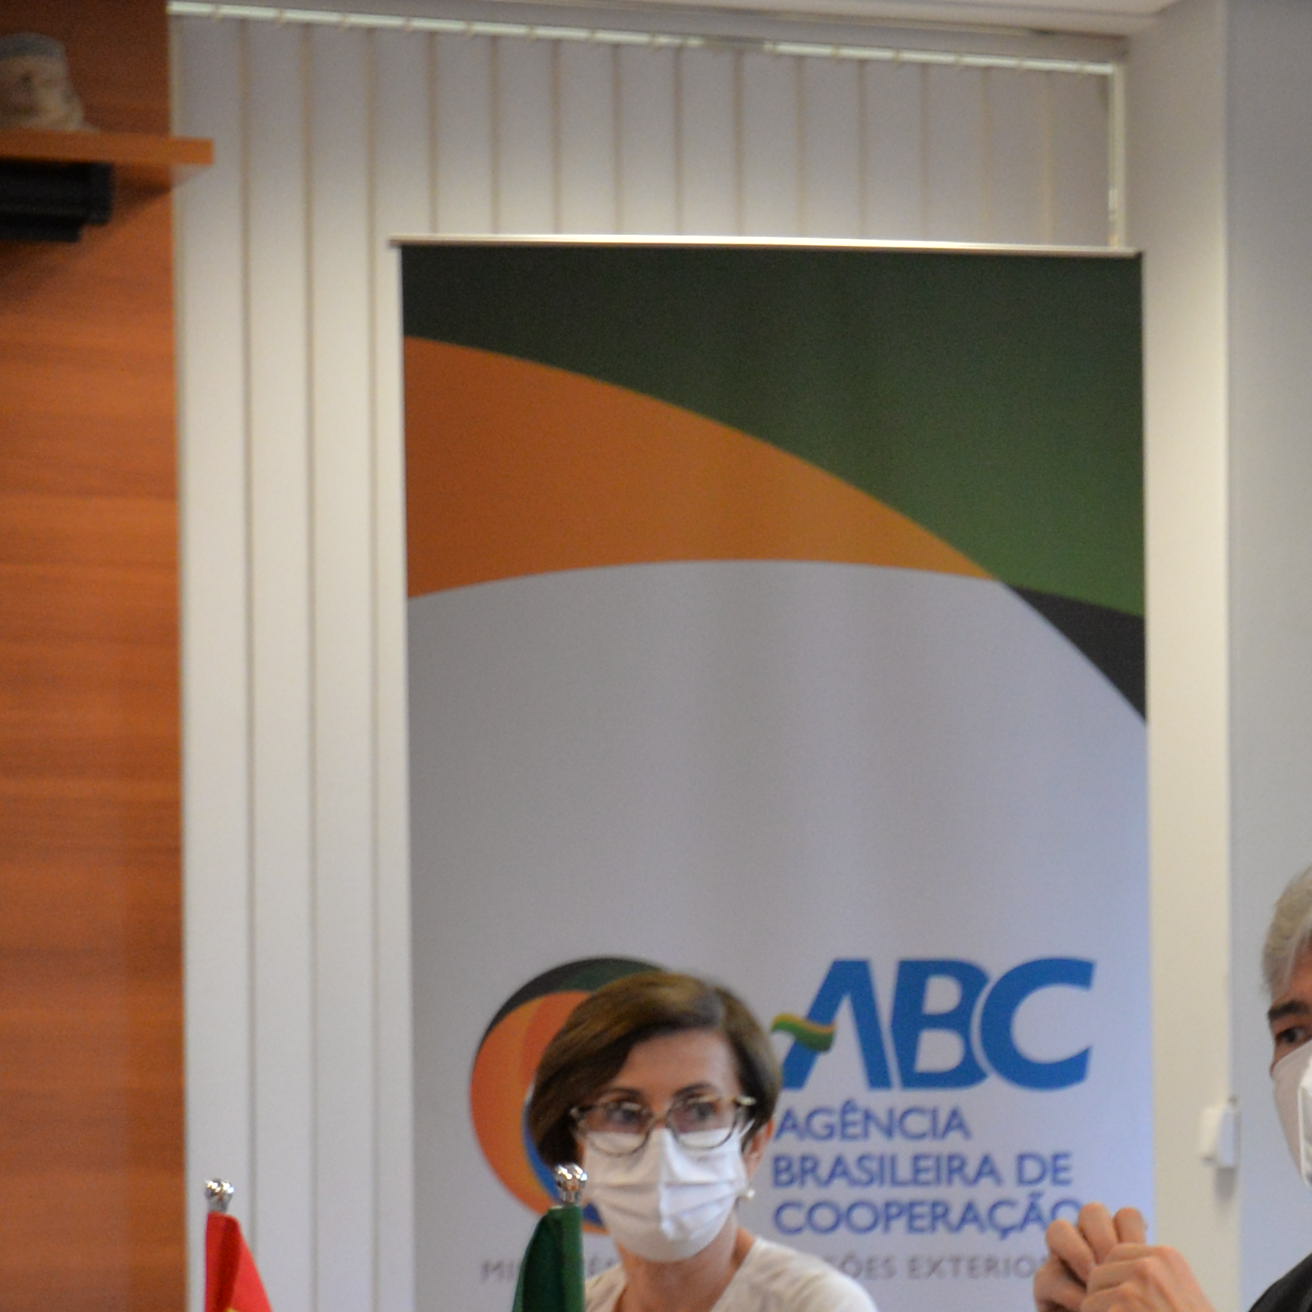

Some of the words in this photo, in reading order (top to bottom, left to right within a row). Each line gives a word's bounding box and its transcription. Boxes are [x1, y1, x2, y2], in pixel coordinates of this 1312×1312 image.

[773, 957, 1096, 1090] ABC
[774, 1099, 970, 1142] AGÊNCIA
[773, 1152, 999, 1187] BRASILEIRA
[1016, 1151, 1072, 1186] DE
